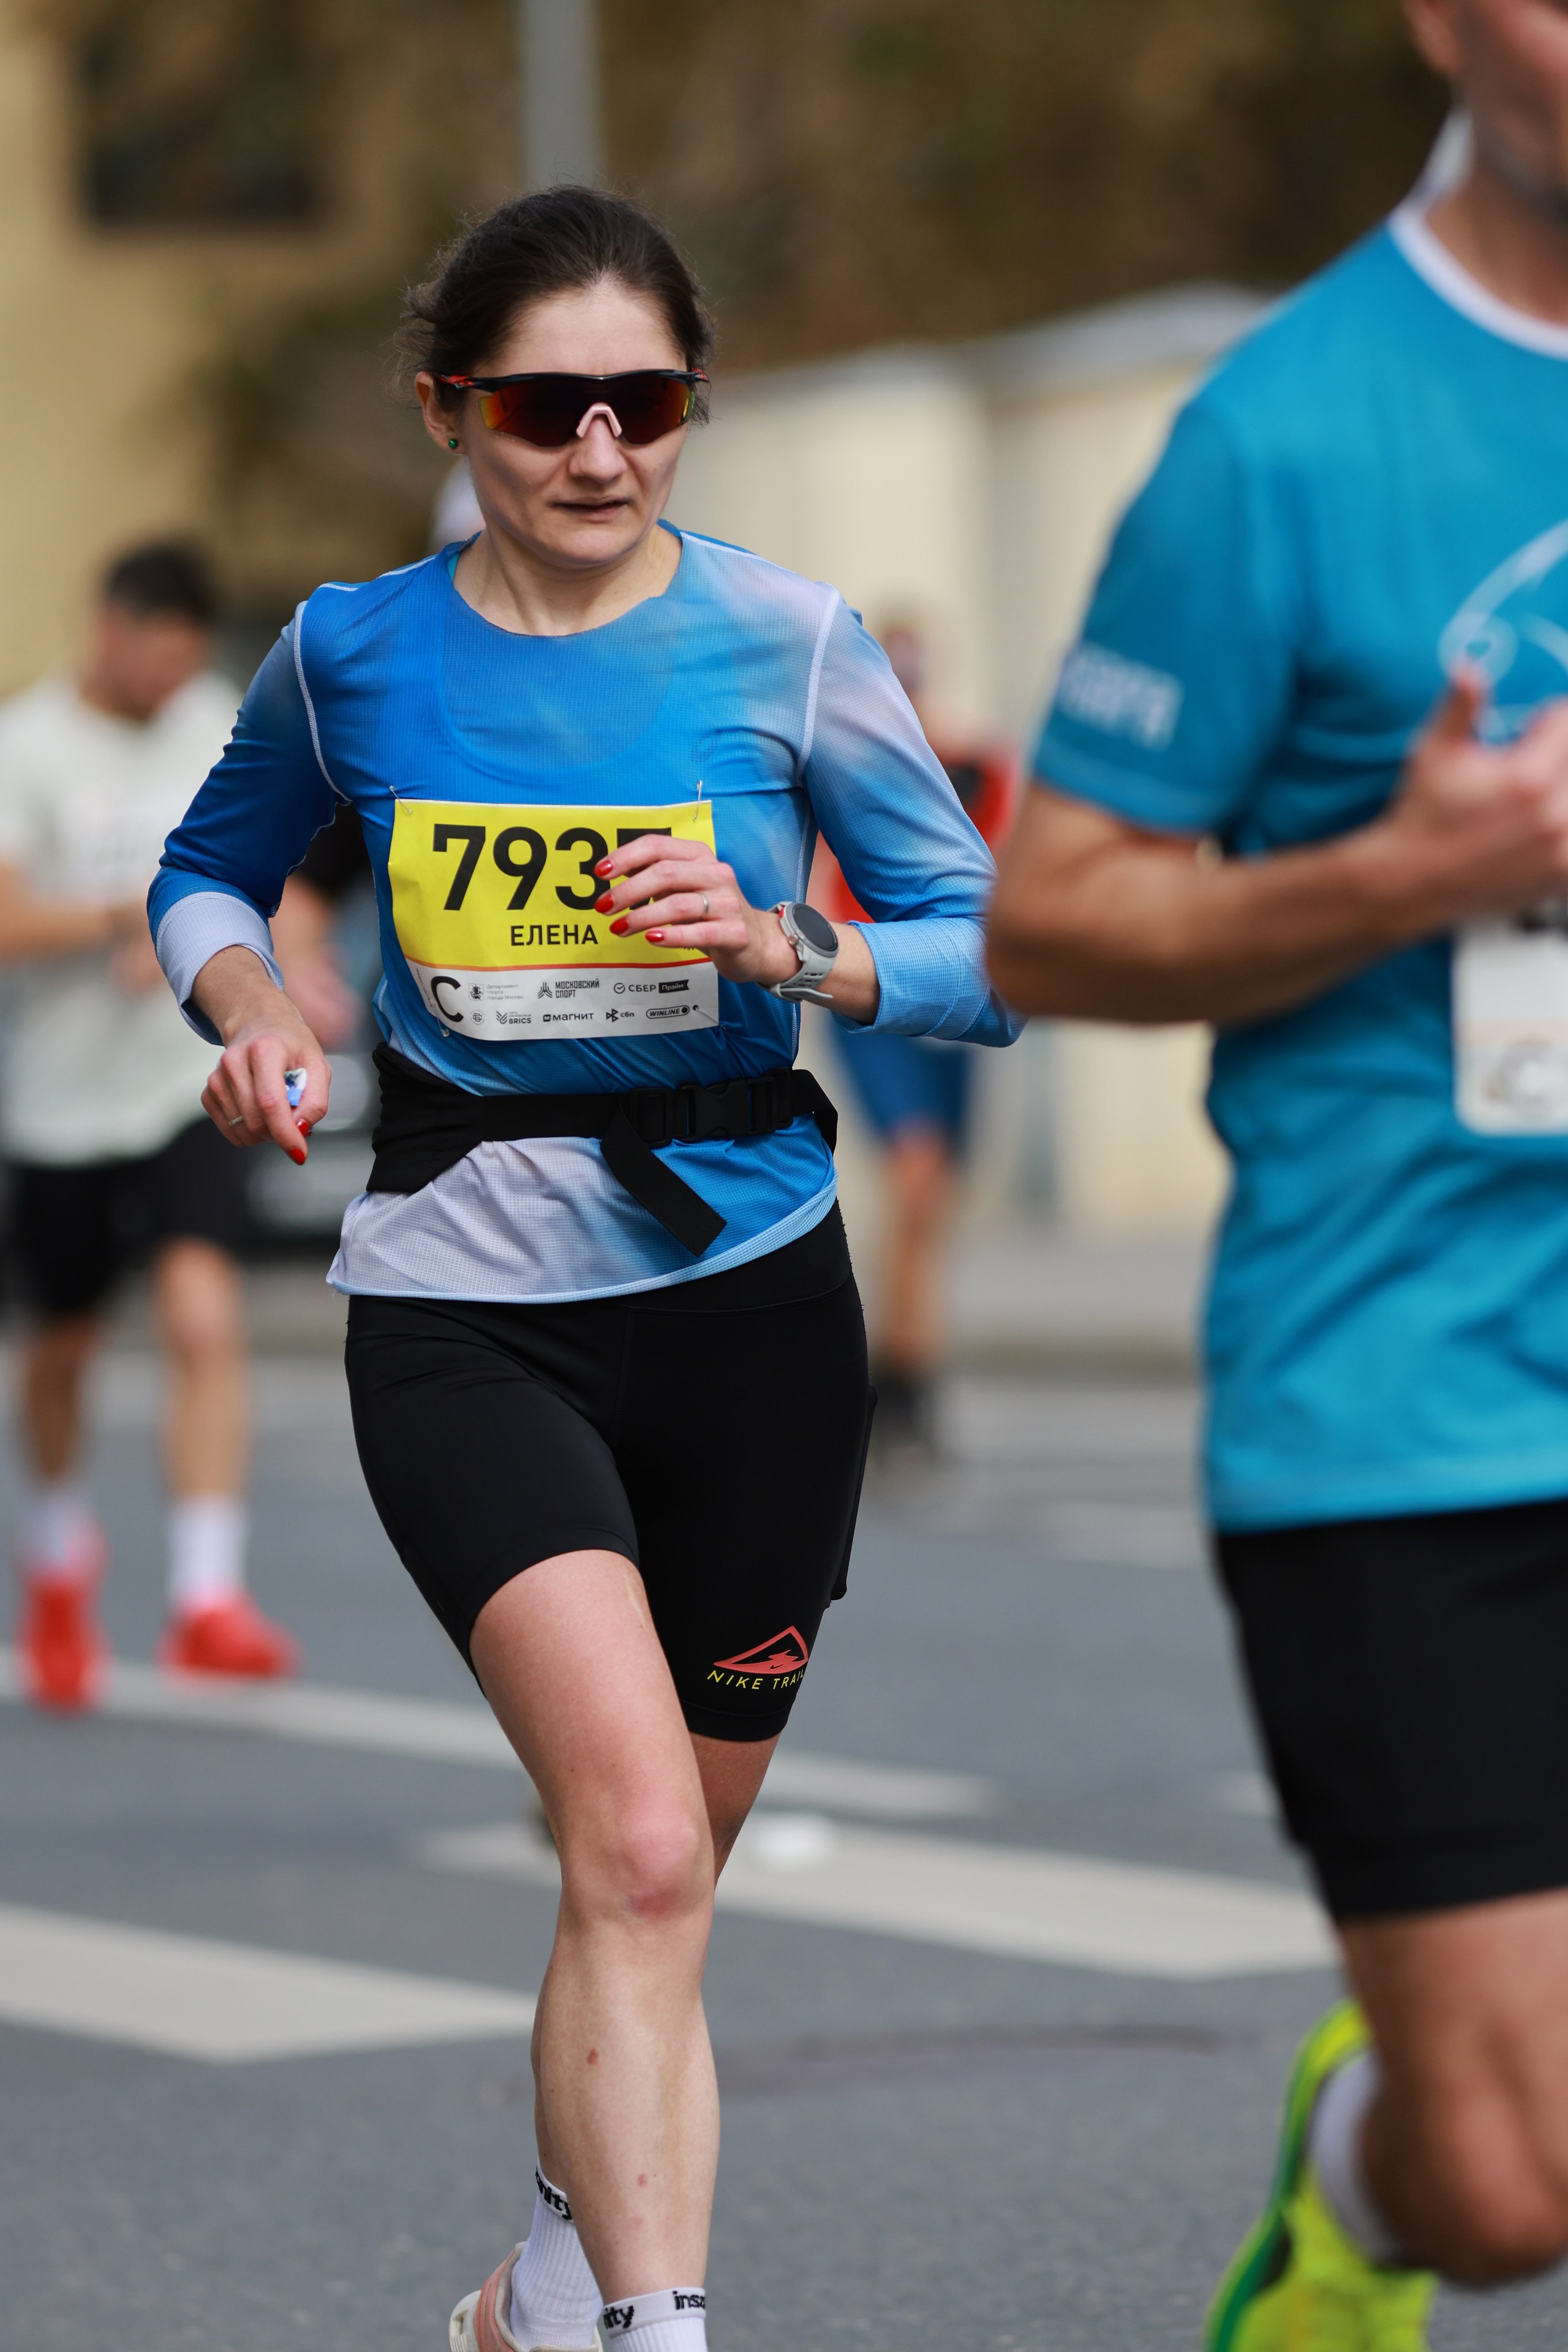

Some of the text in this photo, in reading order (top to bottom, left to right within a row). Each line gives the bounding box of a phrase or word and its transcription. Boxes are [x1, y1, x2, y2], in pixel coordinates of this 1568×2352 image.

[510, 924, 598, 946] ЕЛЕНА
[555, 978, 599, 989] МОСКОВСКИЙ
[662, 982, 684, 991] Прайм
[431, 976, 464, 1022] C
[555, 990, 576, 998] СПОРТ
[649, 1008, 680, 1017] WINLINE
[707, 1669, 804, 1690] NIKE TRAIL
